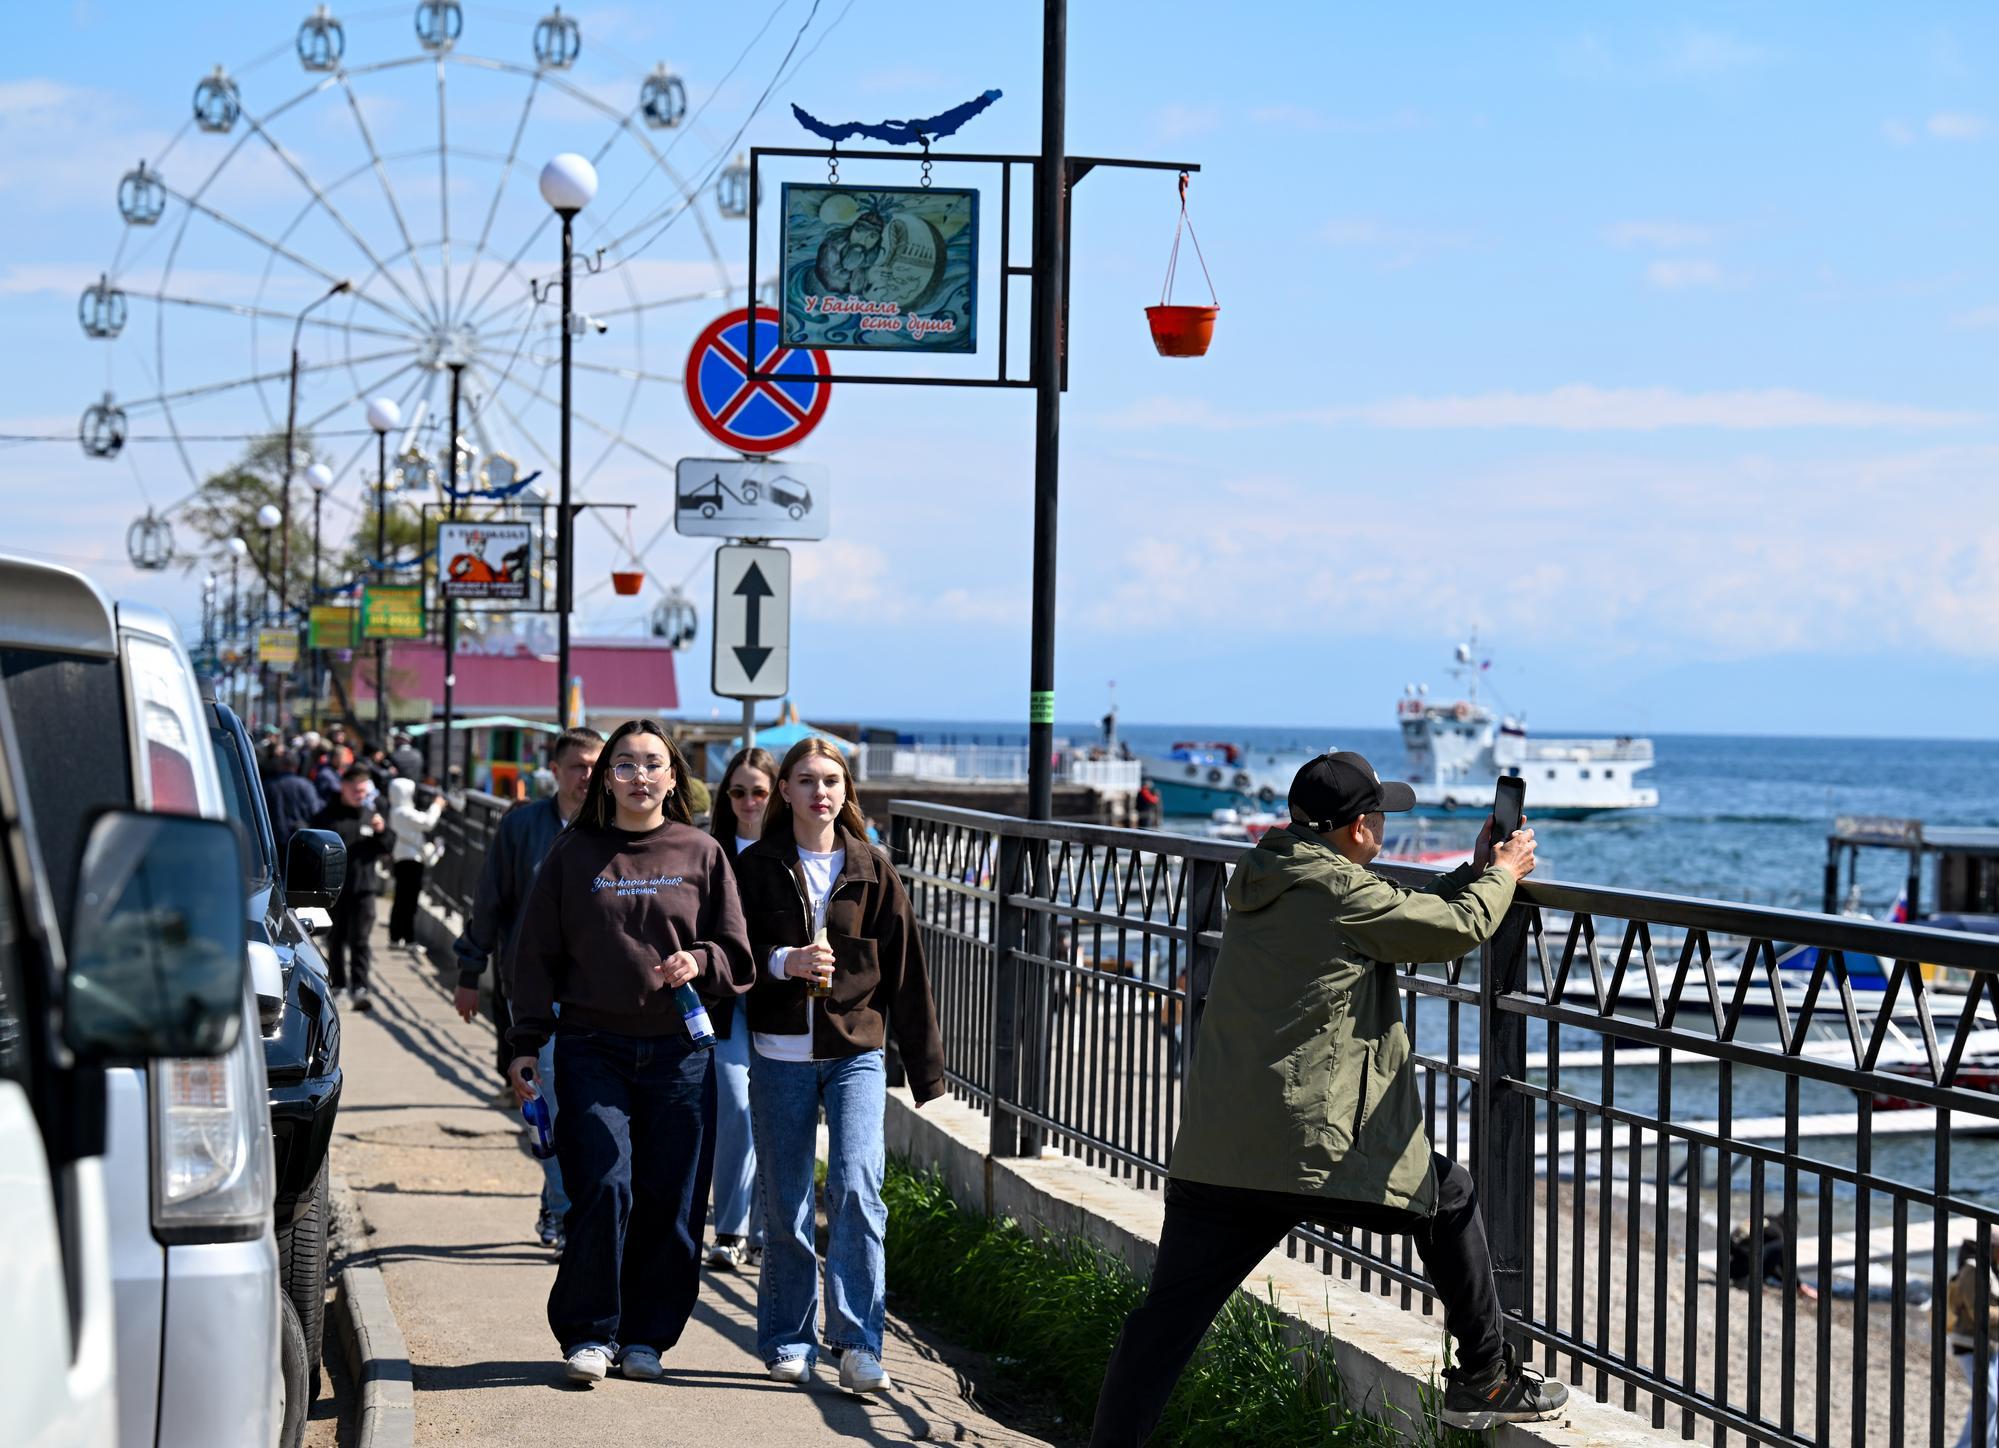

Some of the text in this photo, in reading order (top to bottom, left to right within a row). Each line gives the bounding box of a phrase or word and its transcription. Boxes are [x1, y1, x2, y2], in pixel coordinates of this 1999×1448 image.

[805, 294, 898, 314] У Байкала
[861, 312, 954, 339] есть душа
[591, 875, 683, 892] You know what?
[617, 887, 658, 896] NEVERMIND
